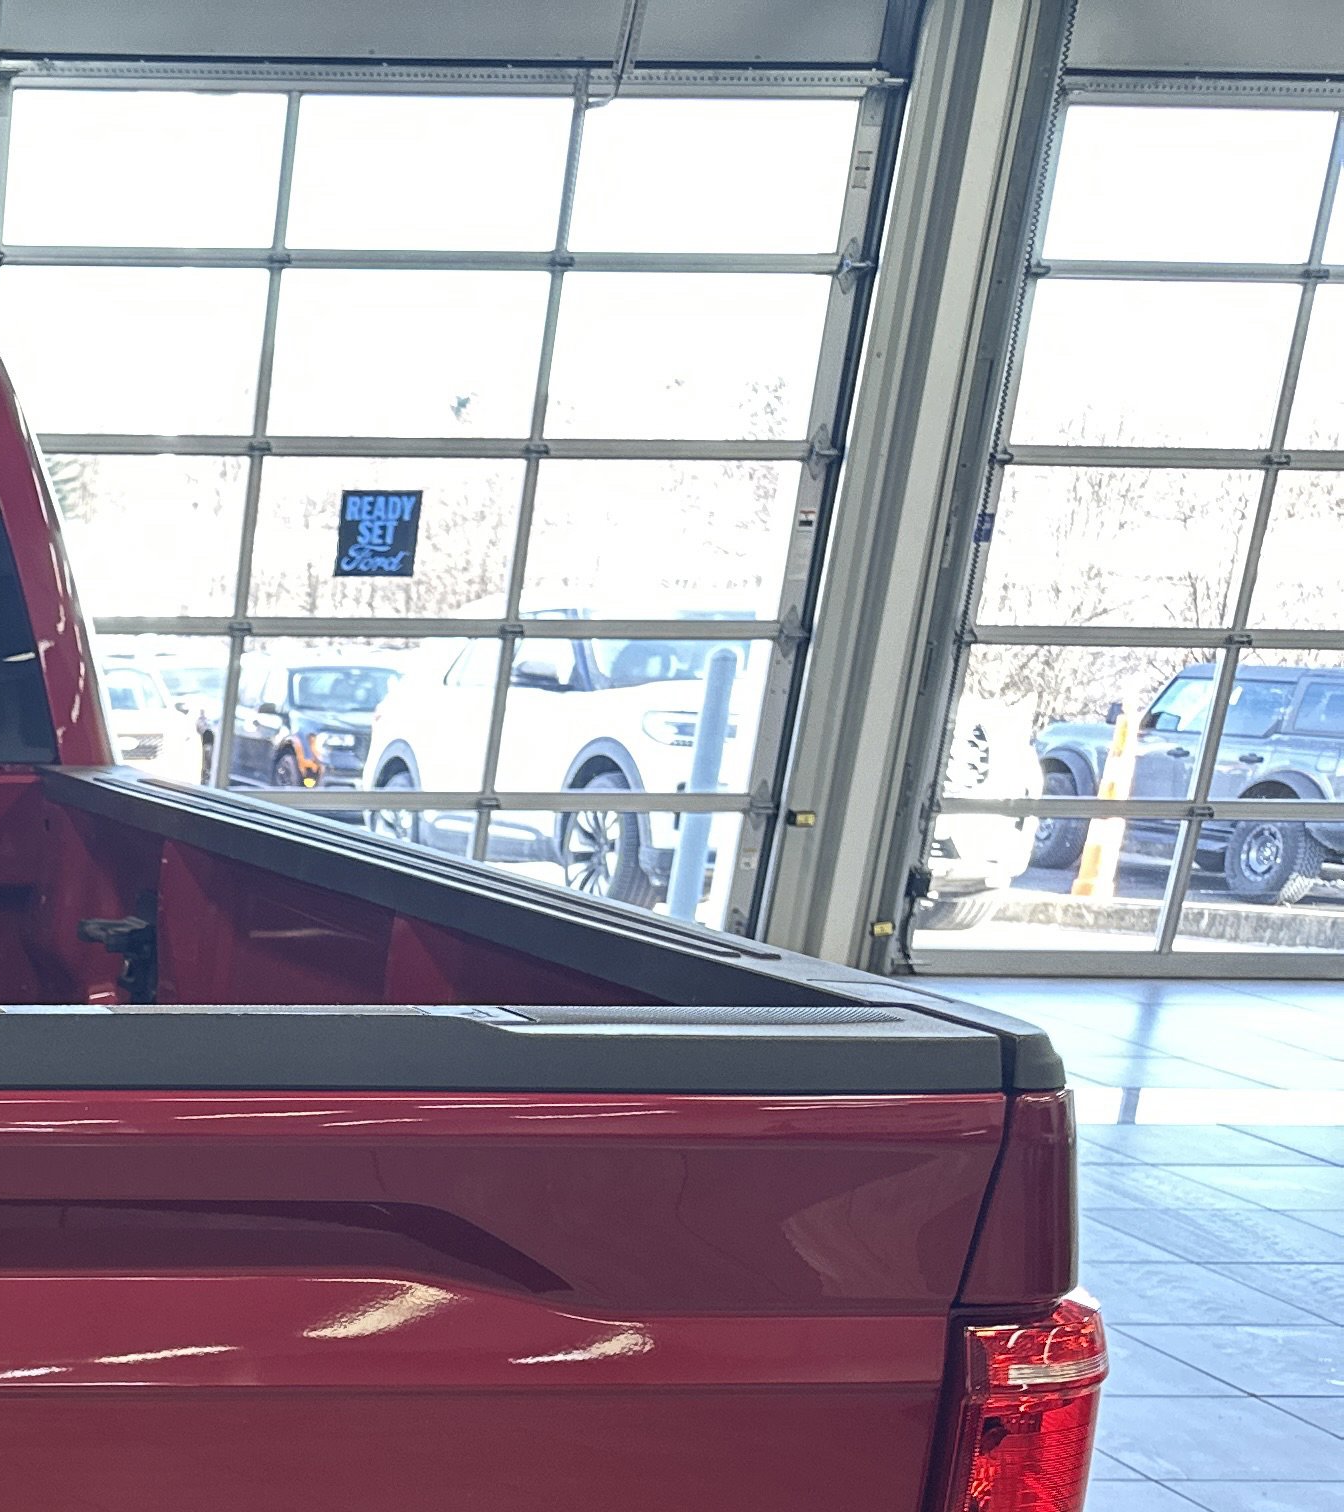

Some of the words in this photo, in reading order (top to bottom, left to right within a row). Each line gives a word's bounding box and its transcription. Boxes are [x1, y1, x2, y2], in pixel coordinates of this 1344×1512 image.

[345, 495, 416, 521] READY
[356, 520, 398, 544] SET
[340, 543, 410, 571] Ford
